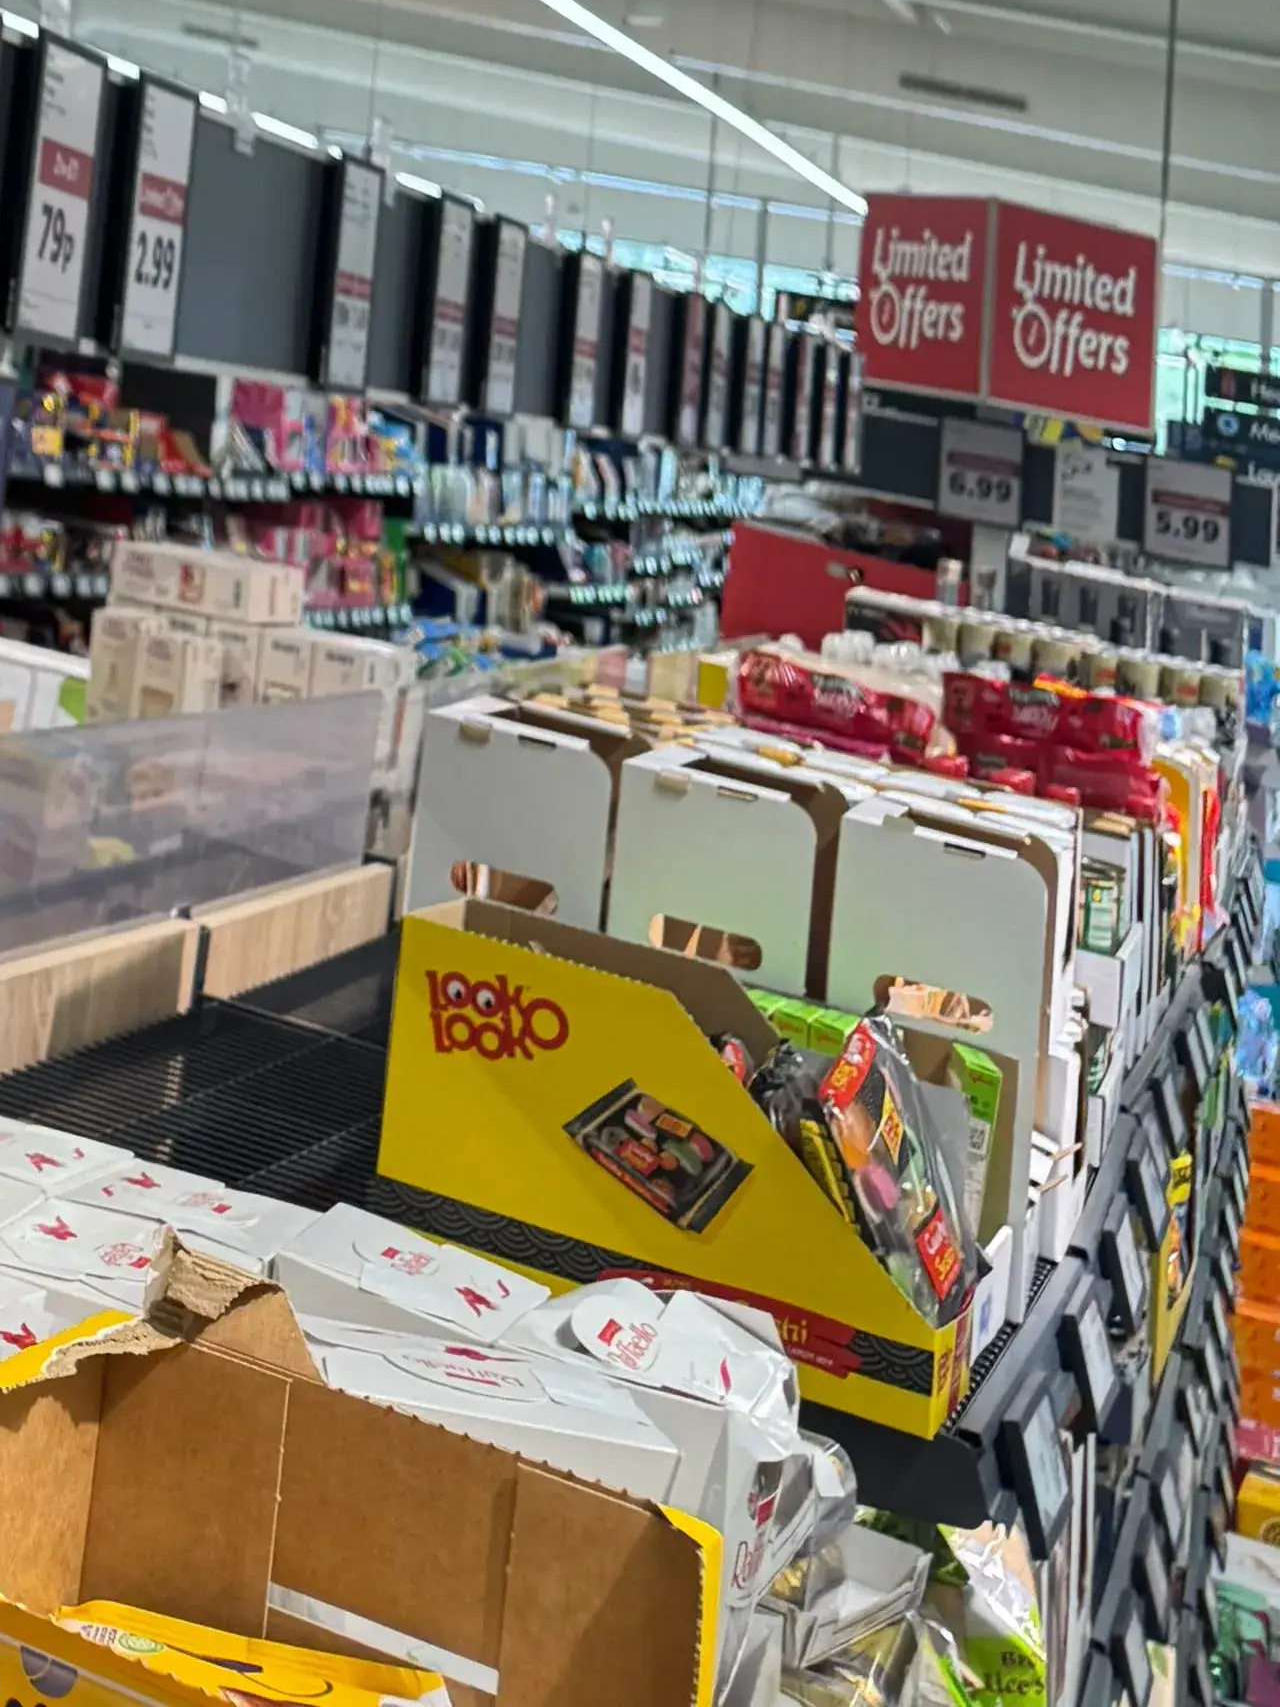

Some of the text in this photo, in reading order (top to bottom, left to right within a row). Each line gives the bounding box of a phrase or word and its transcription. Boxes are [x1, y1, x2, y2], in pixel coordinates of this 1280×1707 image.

[37, 203, 75, 274] 79p
[135, 230, 177, 291] 2.99
[872, 228, 973, 286] Limited
[1014, 241, 1137, 319] Limited
[869, 284, 965, 350] Offers
[1012, 304, 1131, 379] Offers
